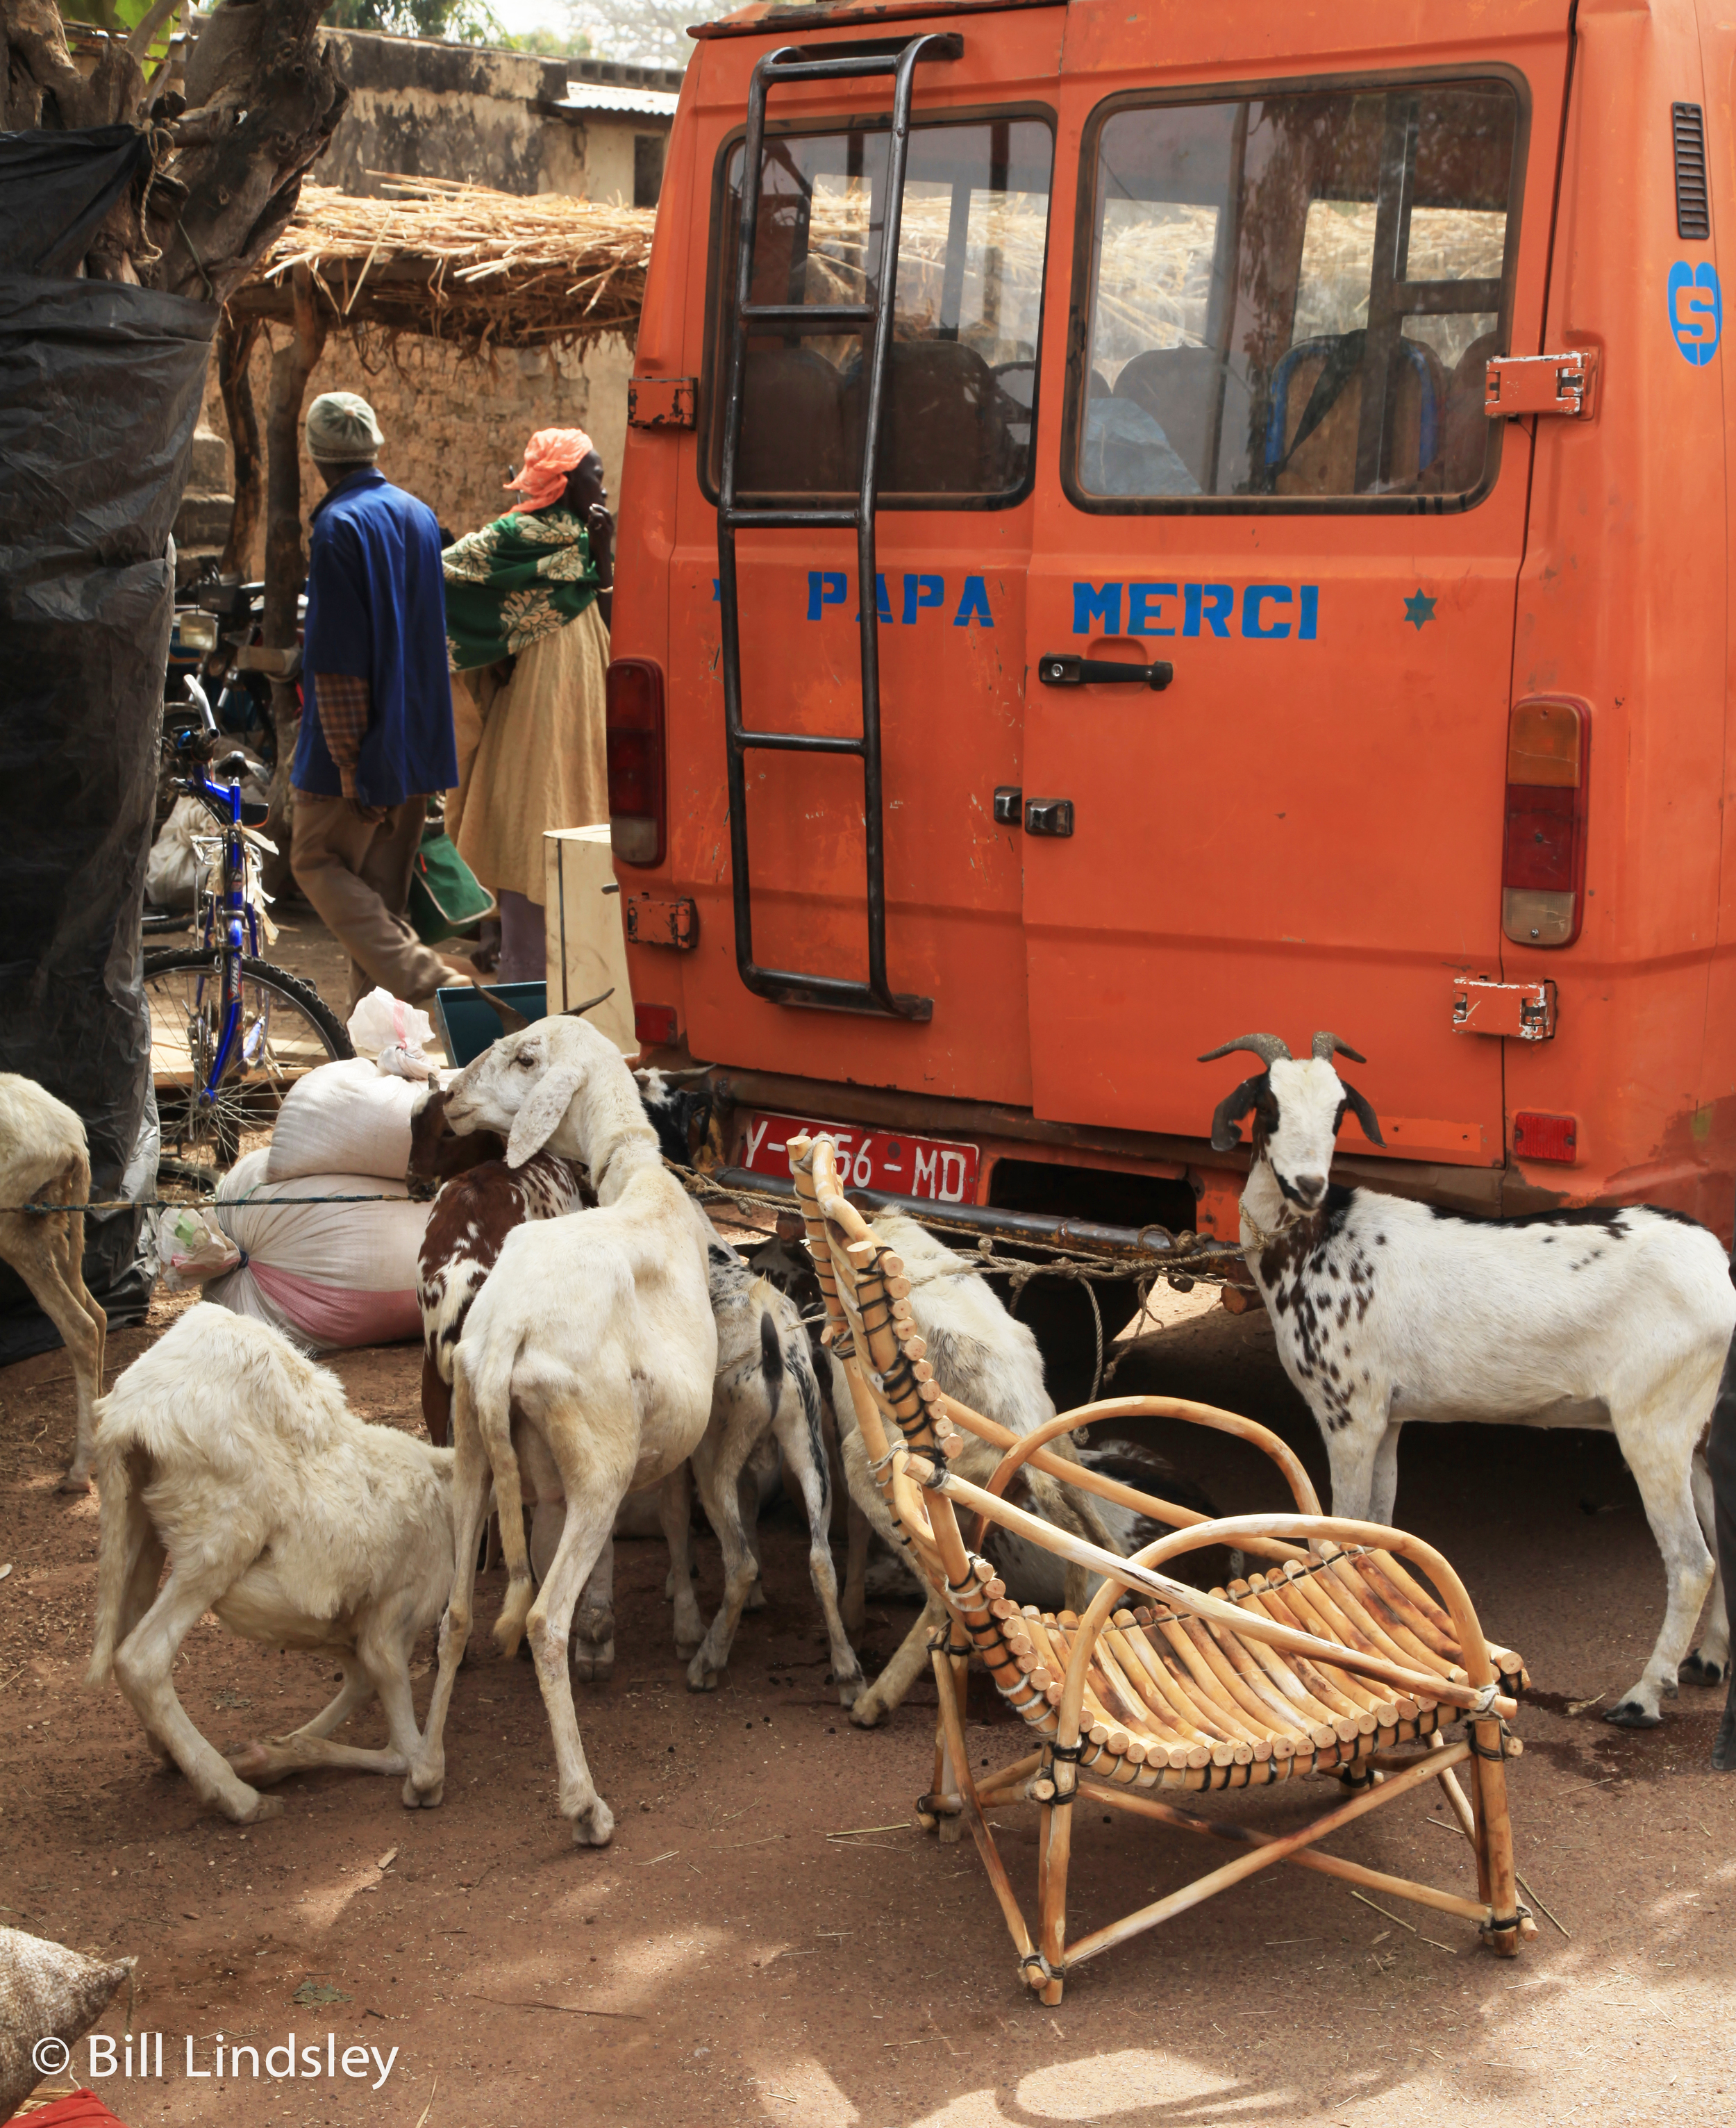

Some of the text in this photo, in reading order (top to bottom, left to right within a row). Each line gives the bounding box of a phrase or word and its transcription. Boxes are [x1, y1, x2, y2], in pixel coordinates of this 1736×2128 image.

[807, 571, 1319, 640] PAPA MERCI
[745, 1120, 967, 1203] Y-56-MD
